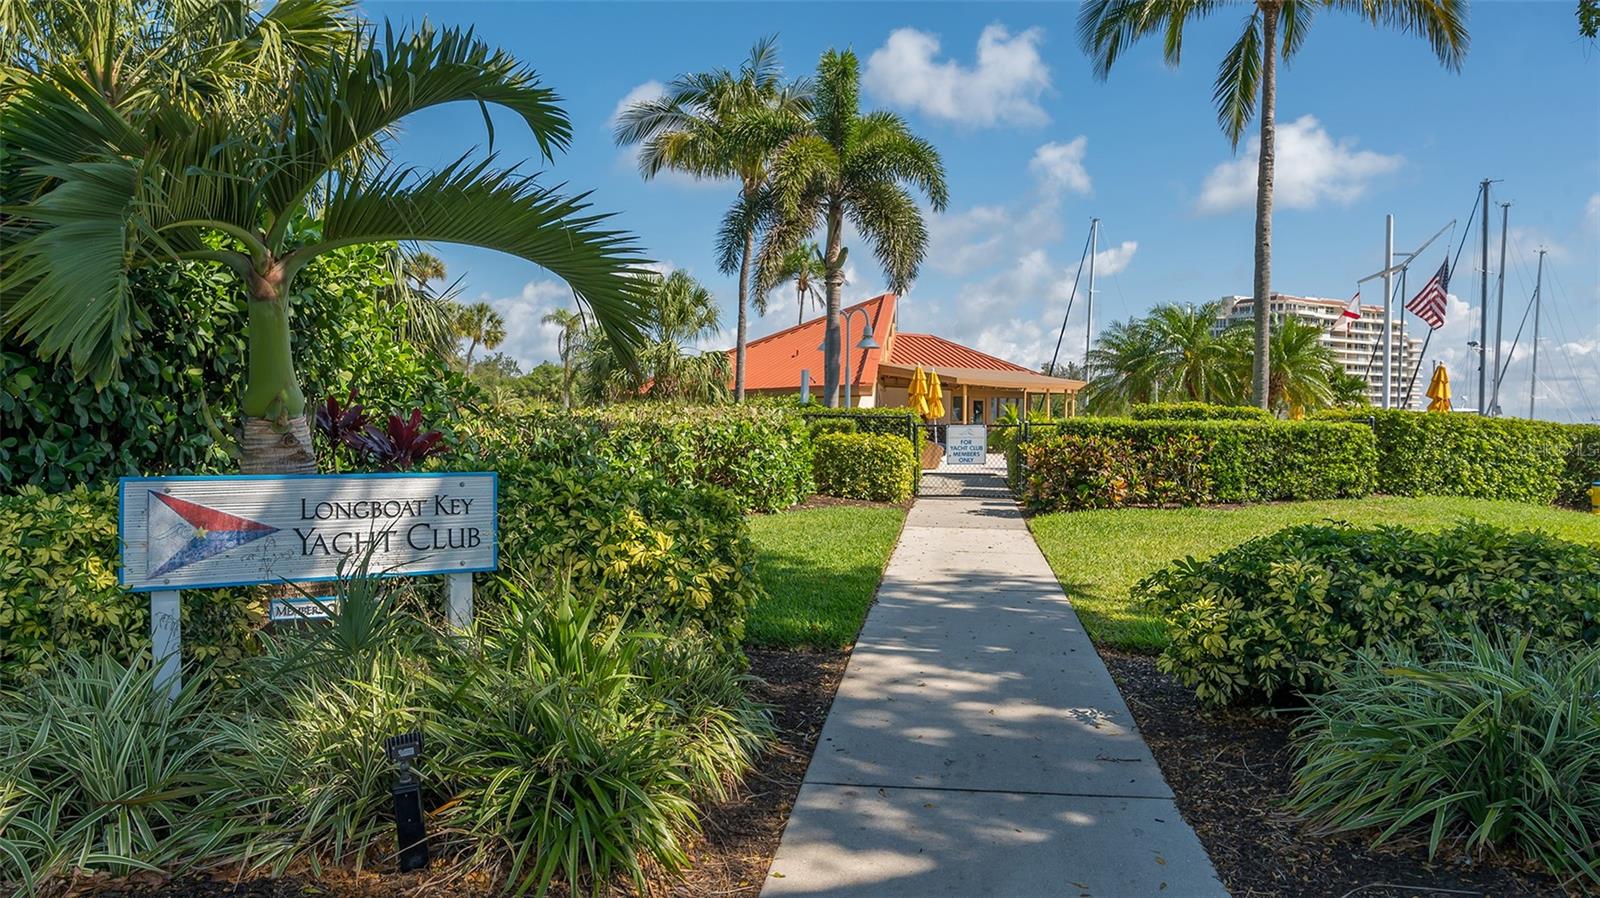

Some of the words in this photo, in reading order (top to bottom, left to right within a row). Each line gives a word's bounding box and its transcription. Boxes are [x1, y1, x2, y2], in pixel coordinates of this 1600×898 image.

[301, 498, 427, 520] LONGBOAT
[434, 494, 474, 516] KEY
[293, 527, 397, 555] YACHT
[407, 523, 481, 550] CLUB
